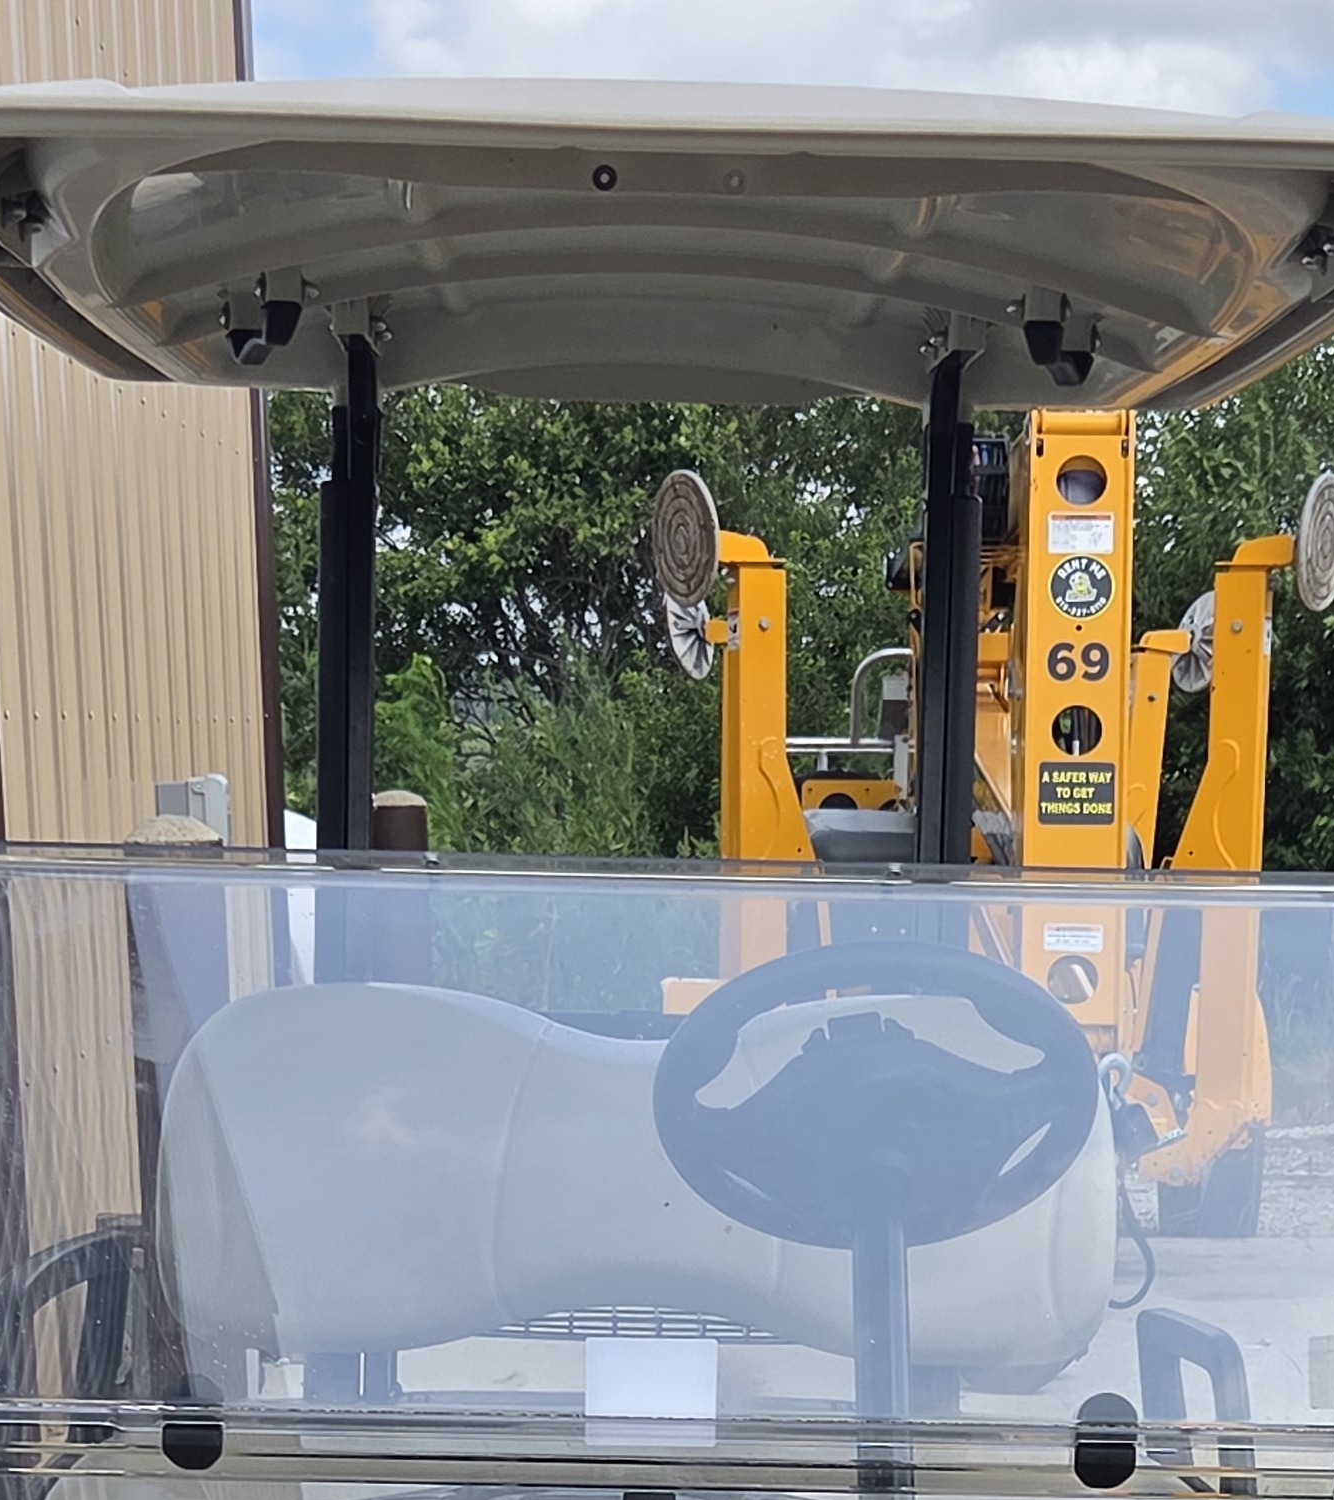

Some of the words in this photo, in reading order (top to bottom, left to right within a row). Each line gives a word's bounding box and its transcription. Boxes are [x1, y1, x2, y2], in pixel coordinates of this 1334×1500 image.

[1057, 558, 1088, 580] RENT
[1089, 561, 1107, 580] ME
[1047, 642, 1110, 682] 69
[1042, 771, 1050, 783] A
[1052, 771, 1087, 784] SAFER
[1088, 771, 1113, 784] WAY
[1056, 787, 1072, 799] TO
[1072, 787, 1095, 799] GET
[1040, 802, 1081, 815] THINGS
[1082, 802, 1113, 815] DONE
